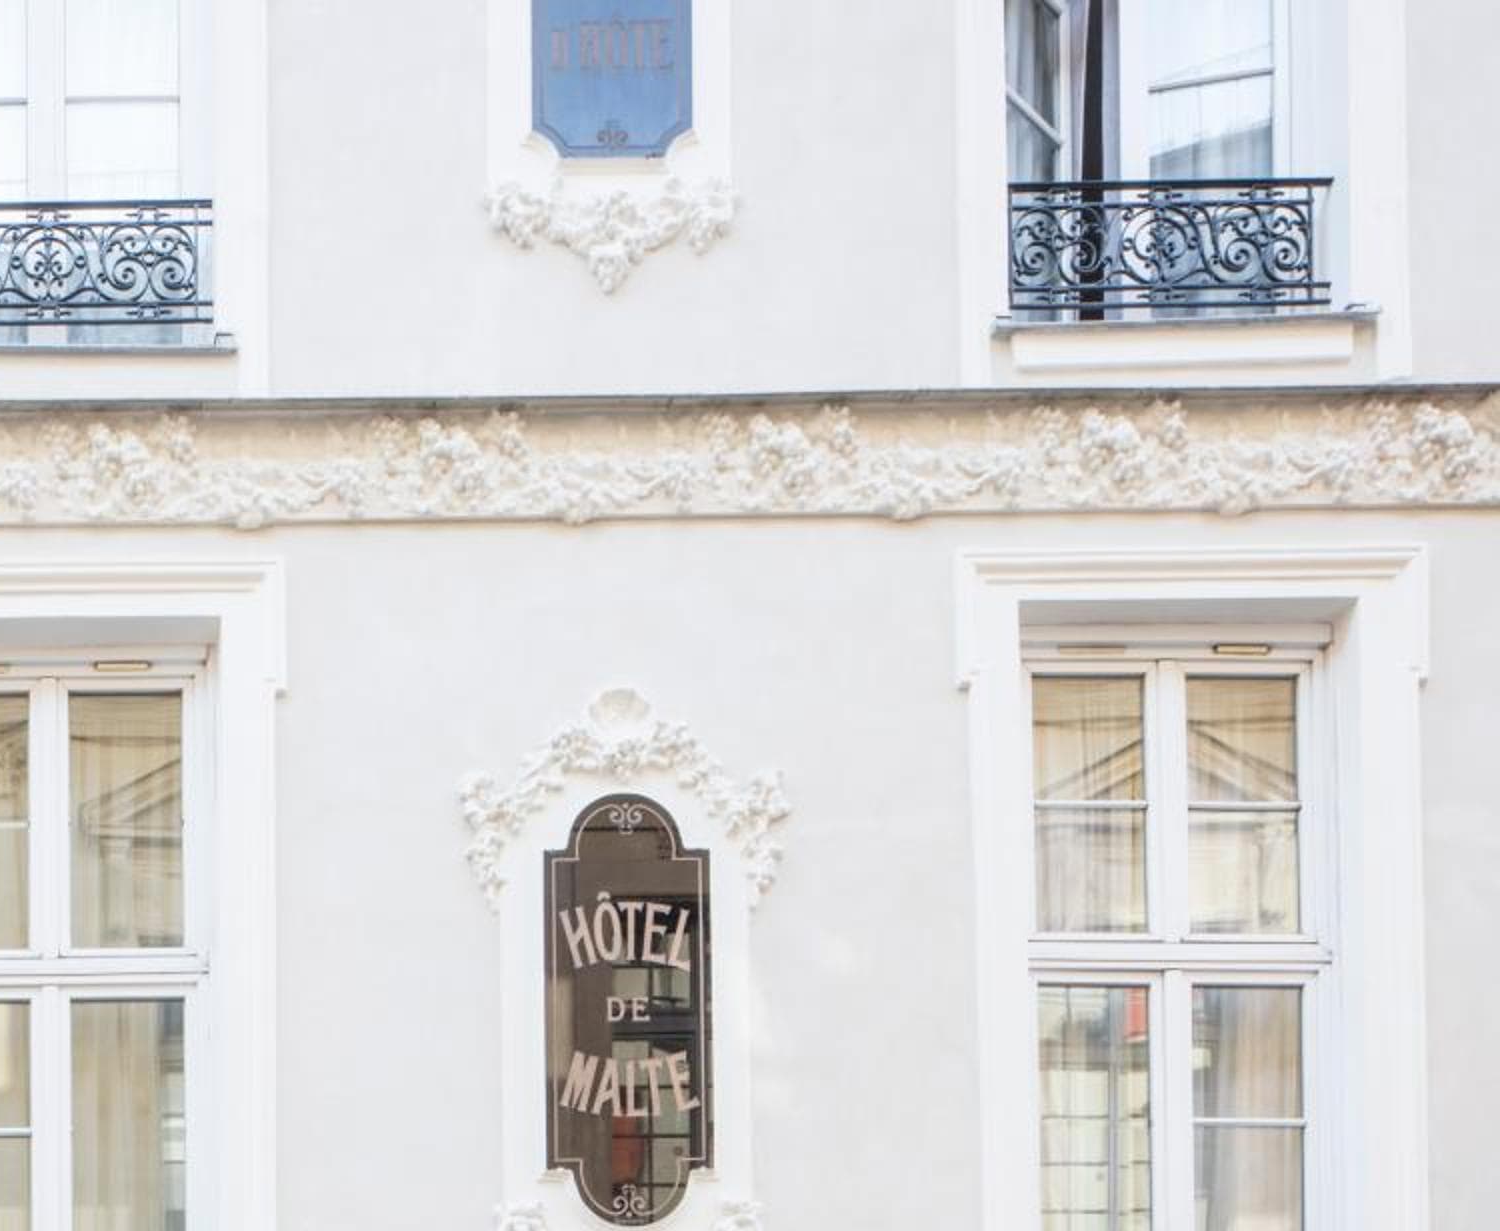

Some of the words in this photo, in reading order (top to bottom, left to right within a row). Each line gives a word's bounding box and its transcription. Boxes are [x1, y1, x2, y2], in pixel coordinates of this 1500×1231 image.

[558, 891, 691, 972] HÔTEL
[606, 996, 651, 1022] DE
[559, 1051, 701, 1117] MALTE
